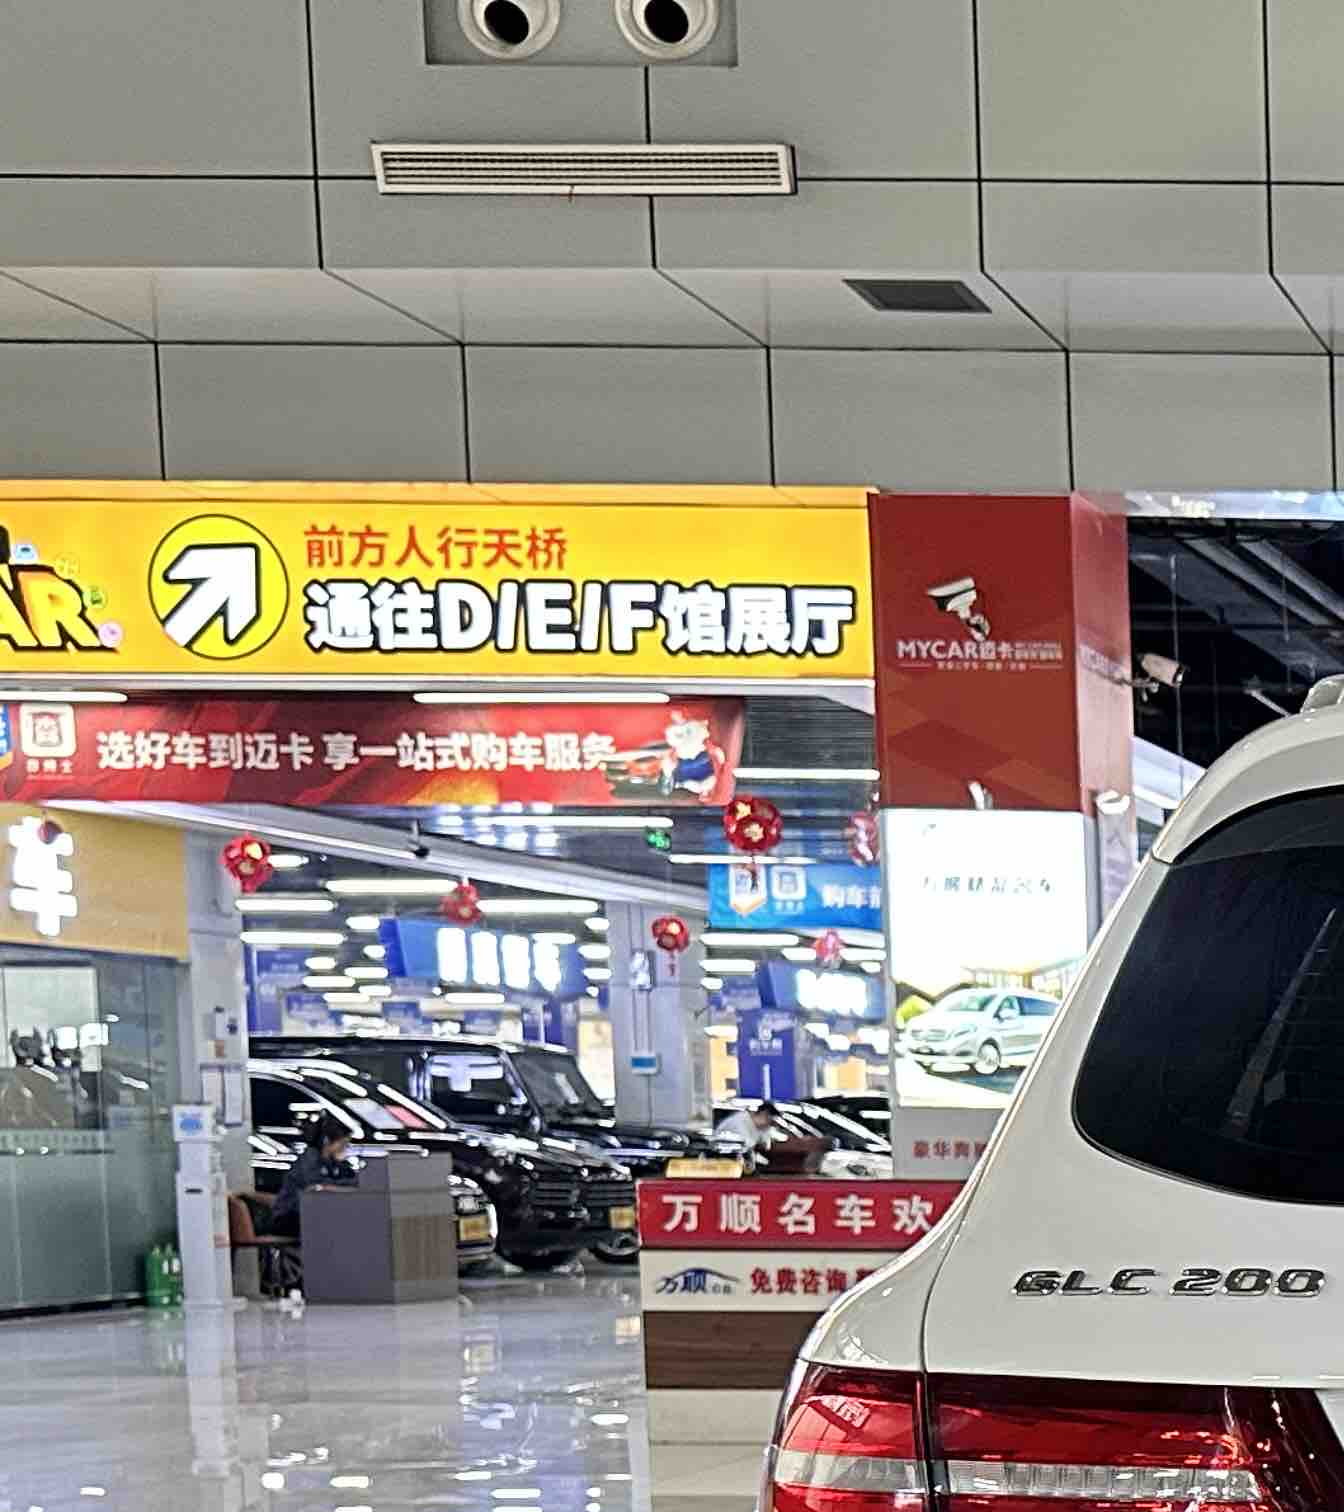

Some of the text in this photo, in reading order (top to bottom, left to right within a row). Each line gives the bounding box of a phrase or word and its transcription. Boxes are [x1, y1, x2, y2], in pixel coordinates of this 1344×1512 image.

[304, 524, 567, 570] 前方人行天桥
[0, 562, 118, 652] AR
[303, 578, 857, 657] 通往D/E/F馆展厅
[96, 731, 617, 772] 选好车到迈卡 享一站式购车服务
[661, 1194, 935, 1235] 万顺名车欢
[1169, 1268, 1326, 1298] 200
